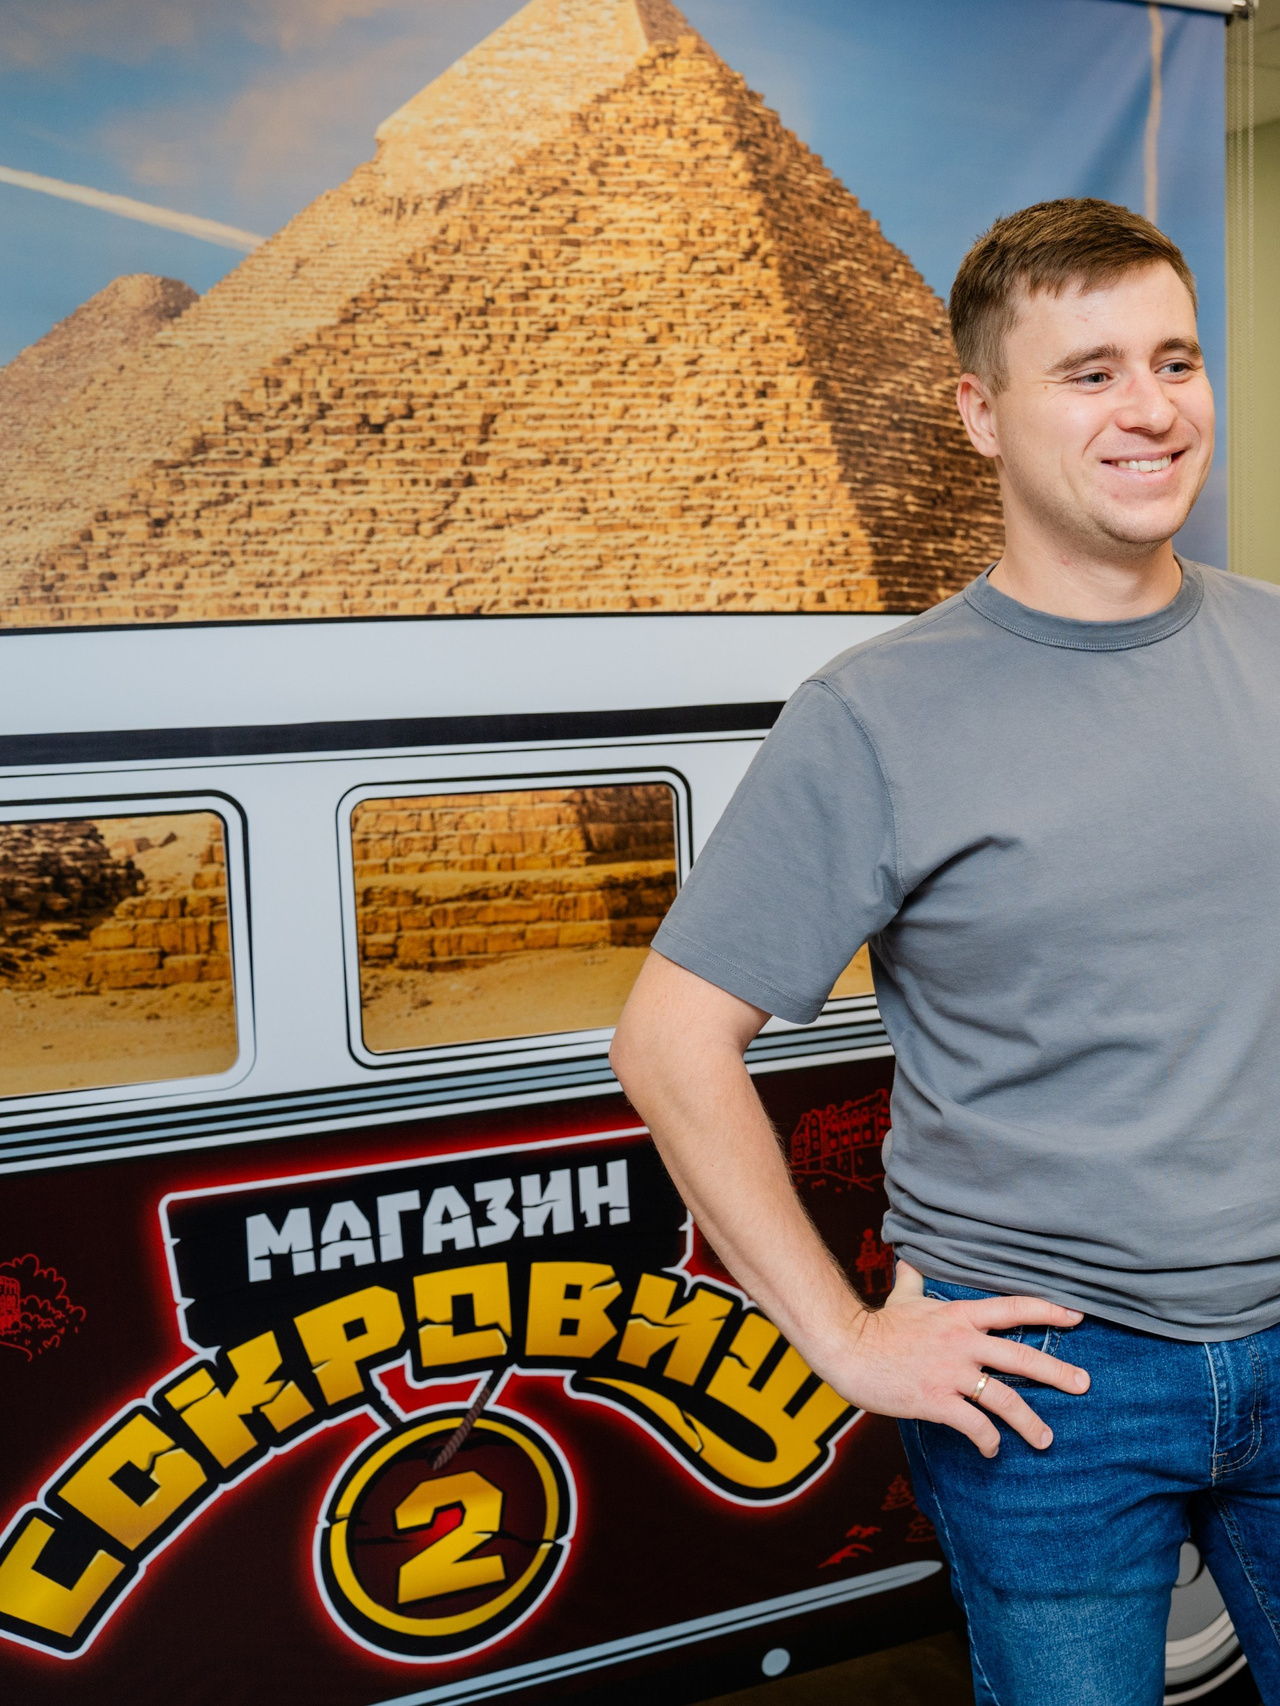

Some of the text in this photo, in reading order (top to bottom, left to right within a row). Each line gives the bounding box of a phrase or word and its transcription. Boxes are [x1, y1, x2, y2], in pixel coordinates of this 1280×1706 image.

[246, 1159, 631, 1283] МАГАЗИН
[0, 1261, 852, 1638] СОКРОВИЩ
[395, 1470, 507, 1605] 2
